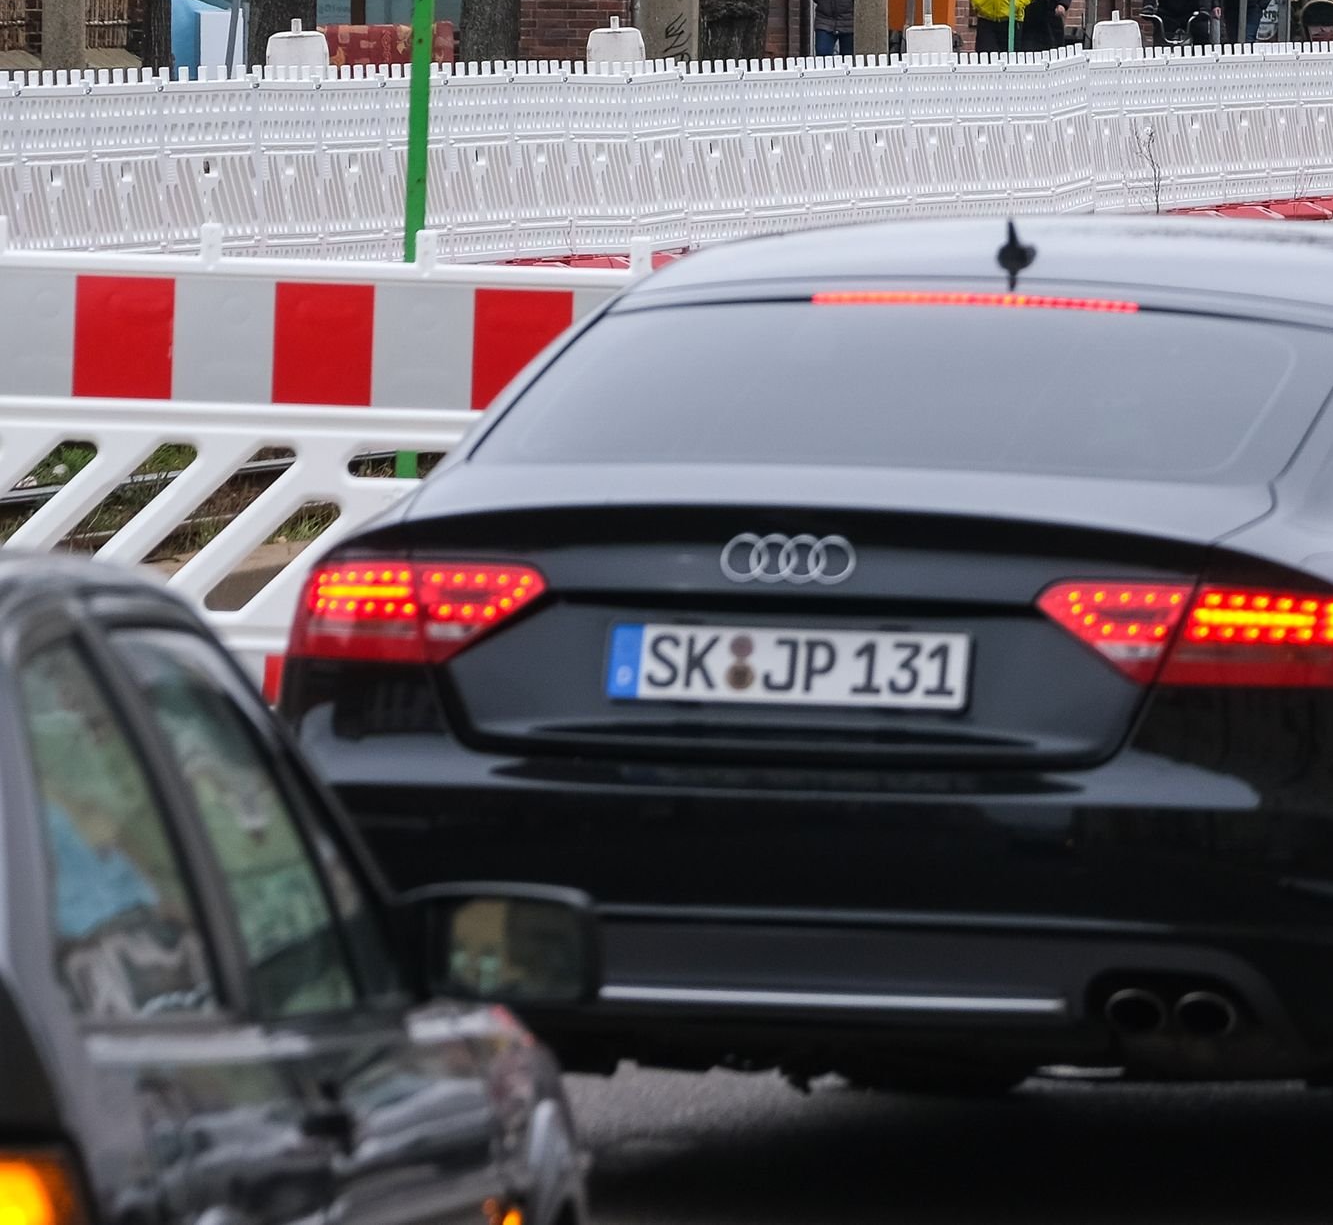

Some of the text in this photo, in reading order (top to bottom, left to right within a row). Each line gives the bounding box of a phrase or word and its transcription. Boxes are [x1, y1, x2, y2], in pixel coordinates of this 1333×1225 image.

[646, 634, 720, 690] SK
[762, 638, 836, 693] JP
[850, 640, 955, 697] 131
